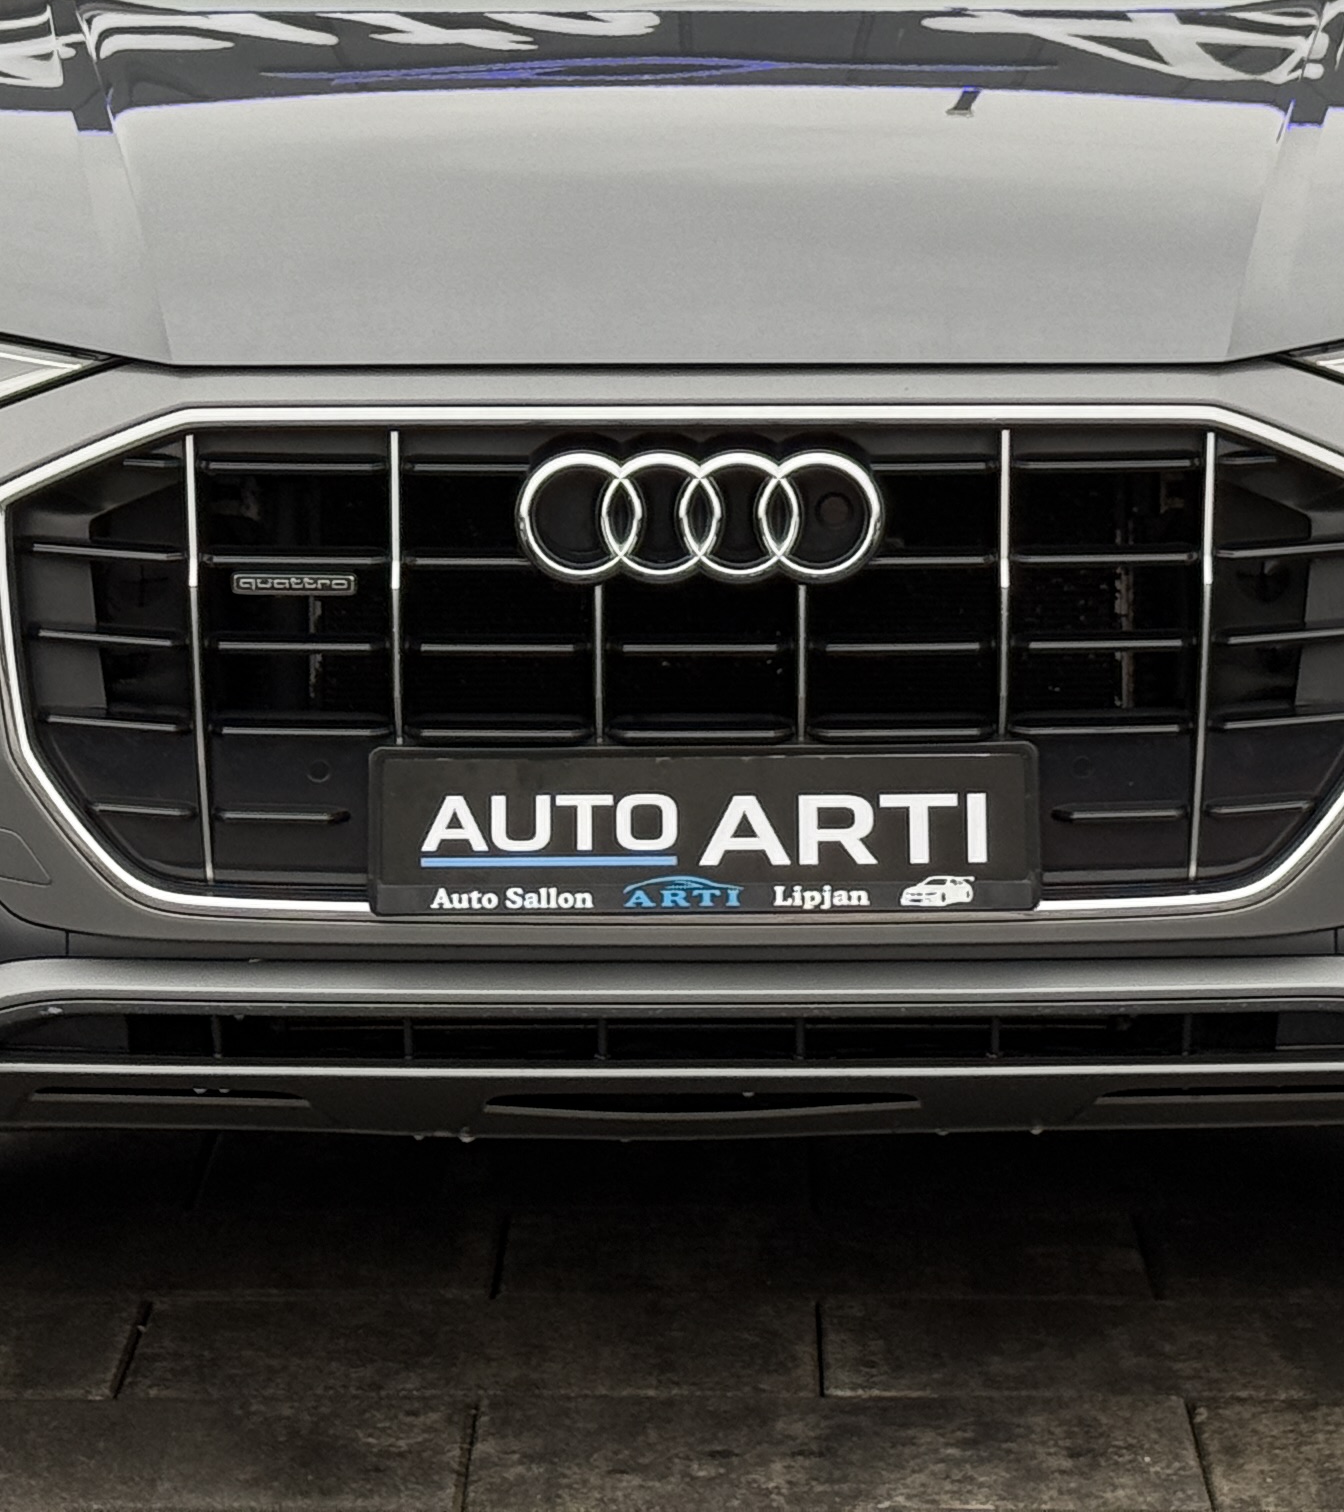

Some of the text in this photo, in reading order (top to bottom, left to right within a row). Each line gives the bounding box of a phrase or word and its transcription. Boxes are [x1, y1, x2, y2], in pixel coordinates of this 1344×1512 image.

[239, 577, 348, 590] quattro
[421, 792, 988, 866] AUTO ARTI
[430, 884, 870, 910] Auto Sallon ARTI Lipjan
